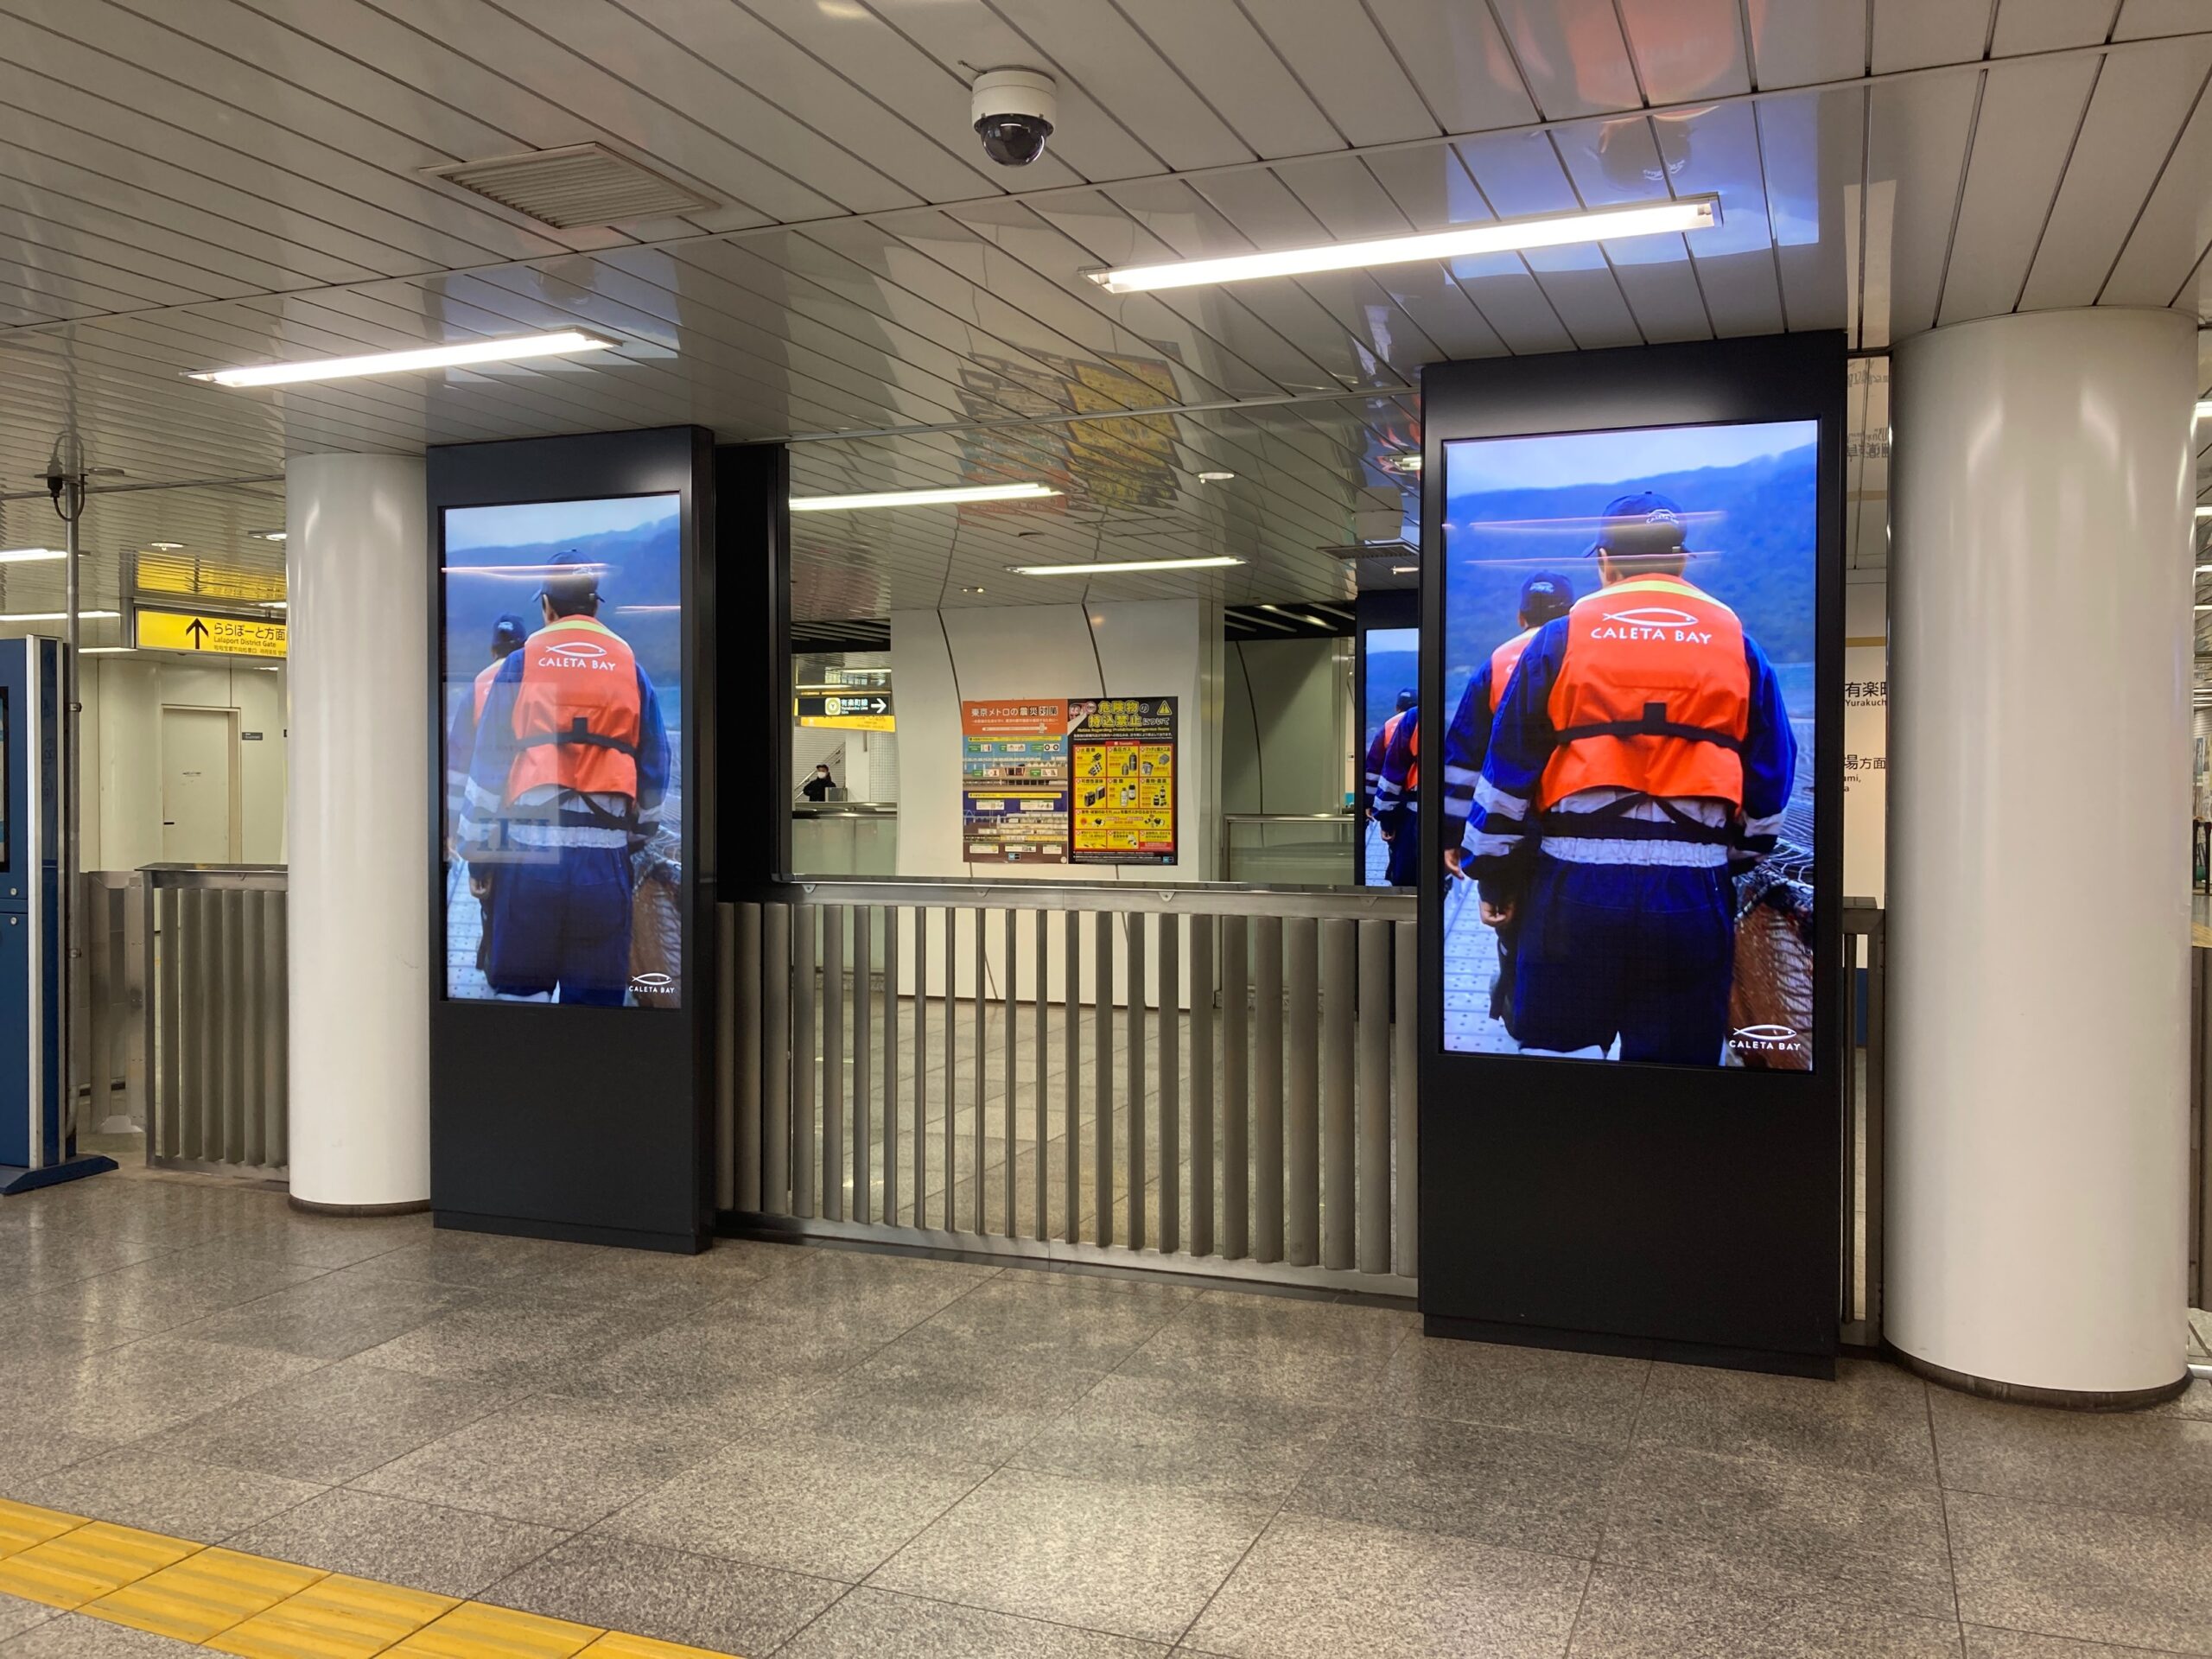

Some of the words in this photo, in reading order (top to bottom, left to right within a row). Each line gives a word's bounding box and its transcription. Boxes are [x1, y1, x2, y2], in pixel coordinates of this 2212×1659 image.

[214, 622, 285, 641] ららぽーと方面
[1590, 627, 1666, 640] CALETA
[1675, 630, 1712, 645] BAY
[214, 636, 239, 645] Lalaport
[240, 638, 261, 647] District
[538, 657, 587, 668] CALETA
[592, 659, 616, 671] BAY
[971, 706, 1058, 716] 東京メトロの震災対策
[1098, 700, 1150, 715] 危険物の
[1088, 714, 1170, 728] 持込禁止について
[1729, 1039, 1774, 1050] CALETA
[1778, 1042, 1801, 1051] BAY
